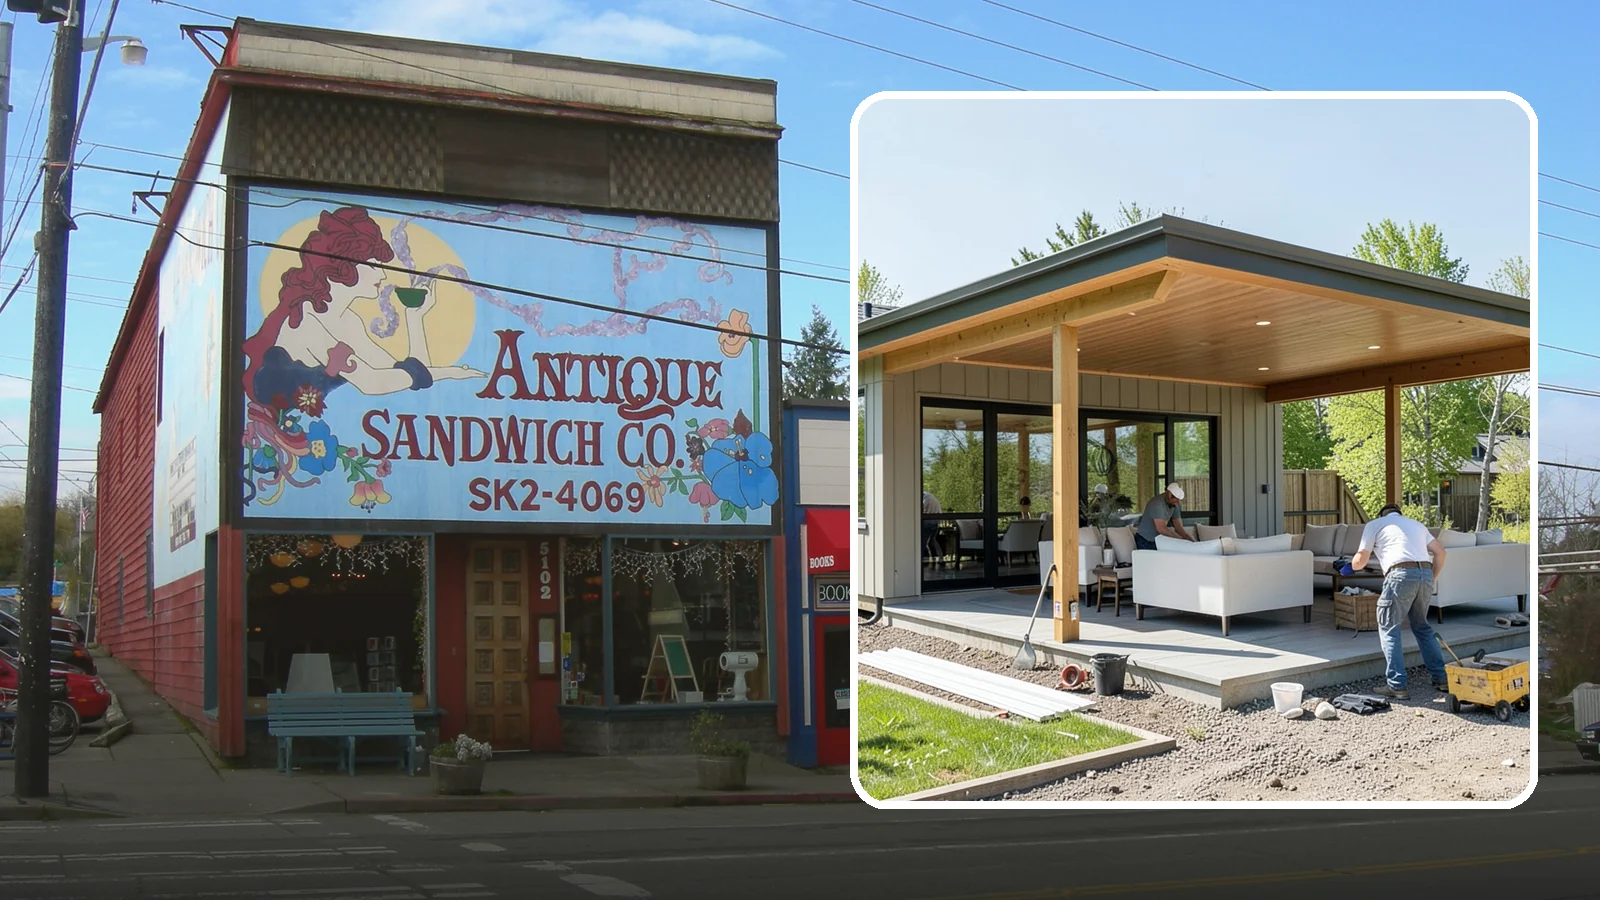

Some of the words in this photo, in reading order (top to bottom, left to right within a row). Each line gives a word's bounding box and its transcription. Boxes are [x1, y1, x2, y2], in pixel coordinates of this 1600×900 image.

[476, 329, 724, 420] ANTIQUE
[361, 408, 605, 467] SANDWICH
[617, 421, 685, 468] CO.
[468, 477, 646, 513] SK2-4069
[540, 541, 552, 600] 5102
[809, 555, 835, 569] BOOKS
